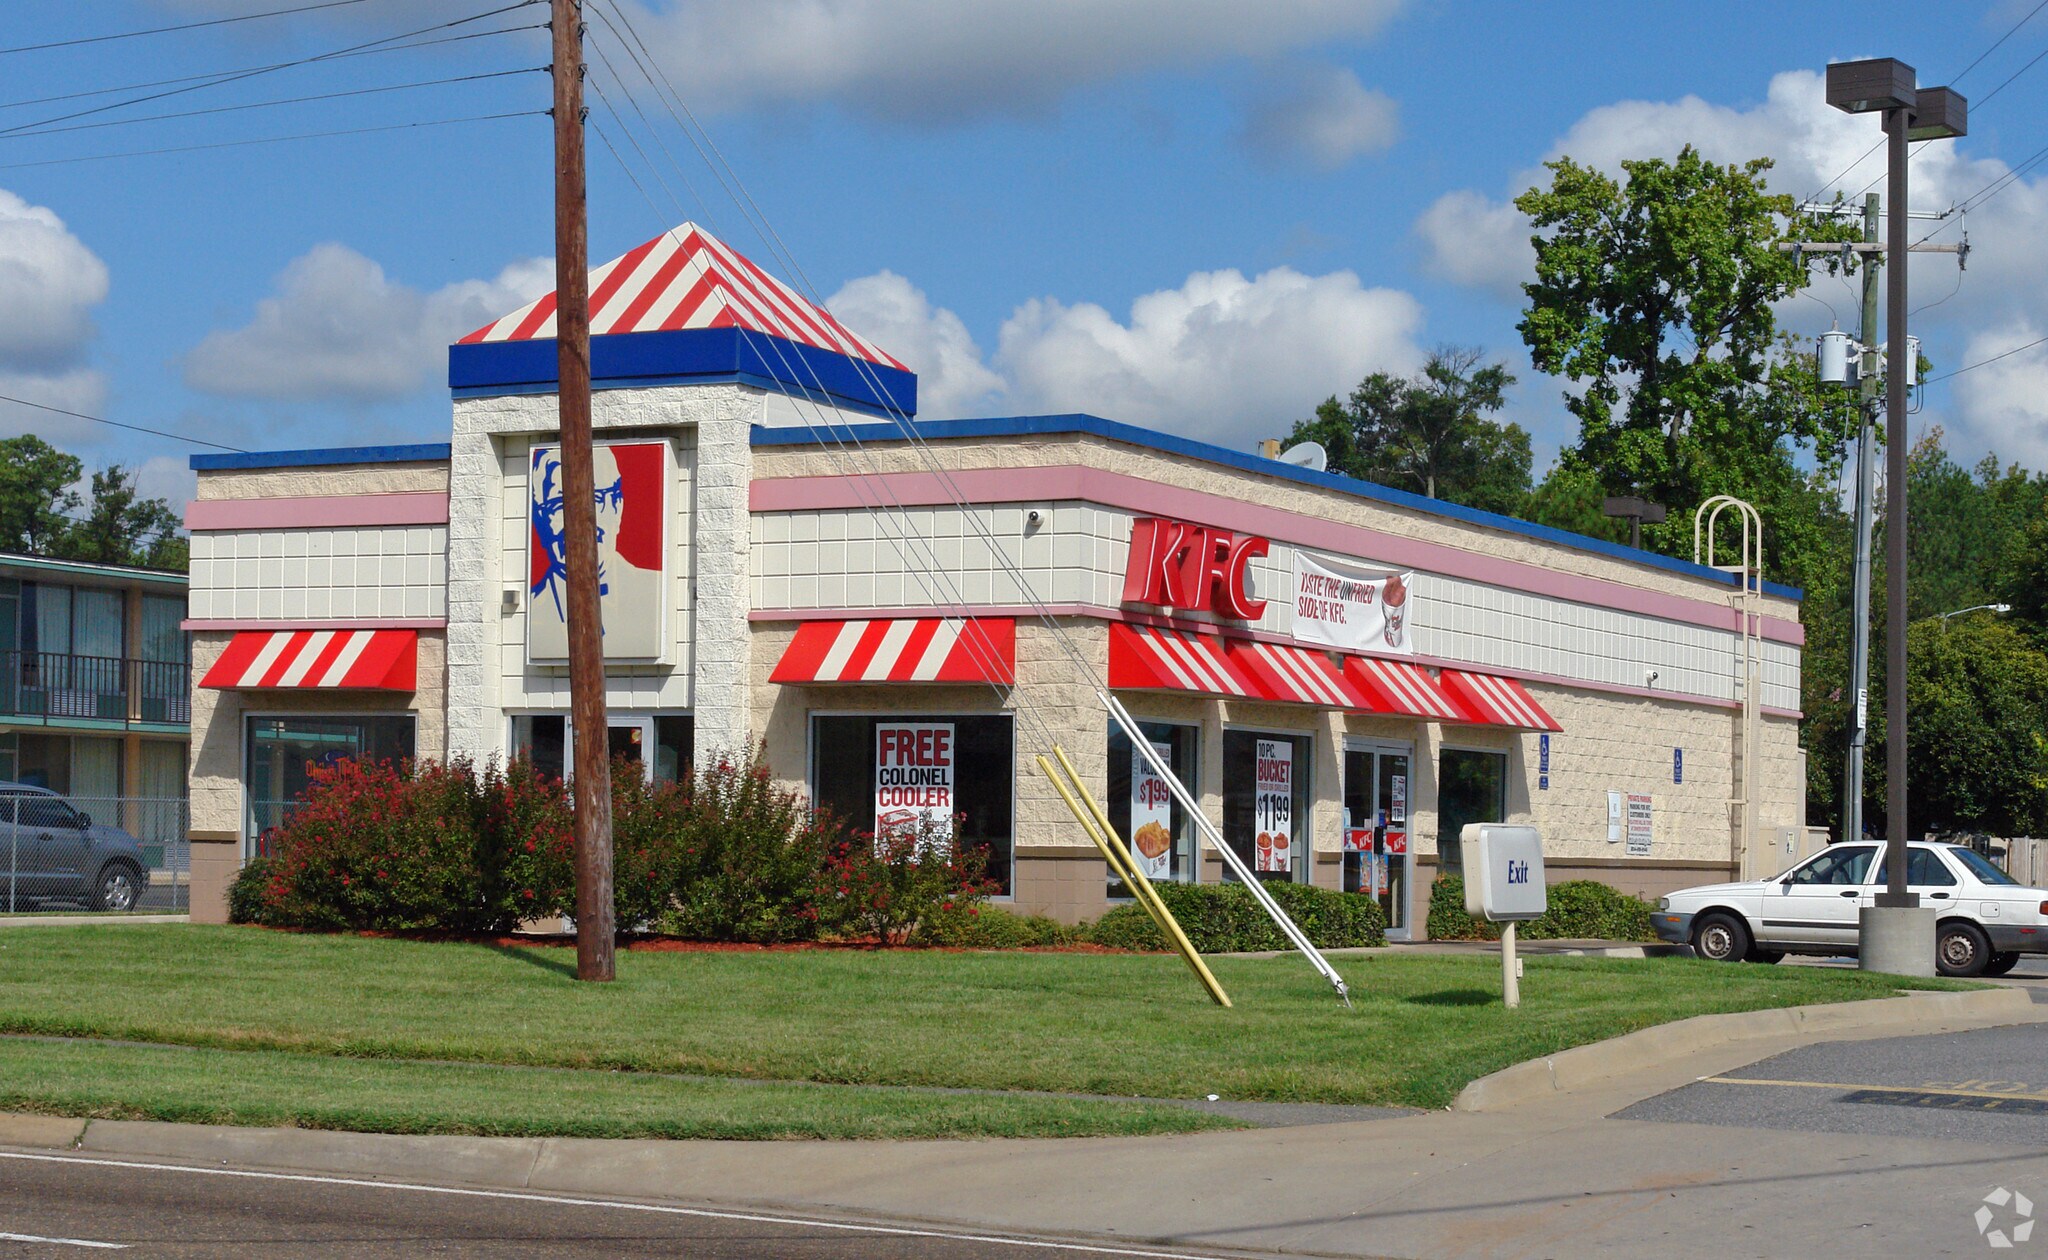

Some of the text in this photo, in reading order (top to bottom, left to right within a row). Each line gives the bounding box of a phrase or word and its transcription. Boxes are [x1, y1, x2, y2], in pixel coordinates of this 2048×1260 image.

[1121, 517, 1270, 621] KFC
[1300, 572, 1376, 605] TASTE THE UNFRIED
[1298, 596, 1347, 625] SIDE OF KFC.
[879, 729, 950, 766] FREE
[1258, 742, 1265, 758] 10
[879, 768, 950, 786] COLONEL
[1258, 758, 1291, 783] BUCKET
[879, 787, 950, 807] COOLER
[1359, 832, 1372, 849] KFC
[1393, 834, 1406, 851] KFC
[1508, 859, 1529, 884] Exit
